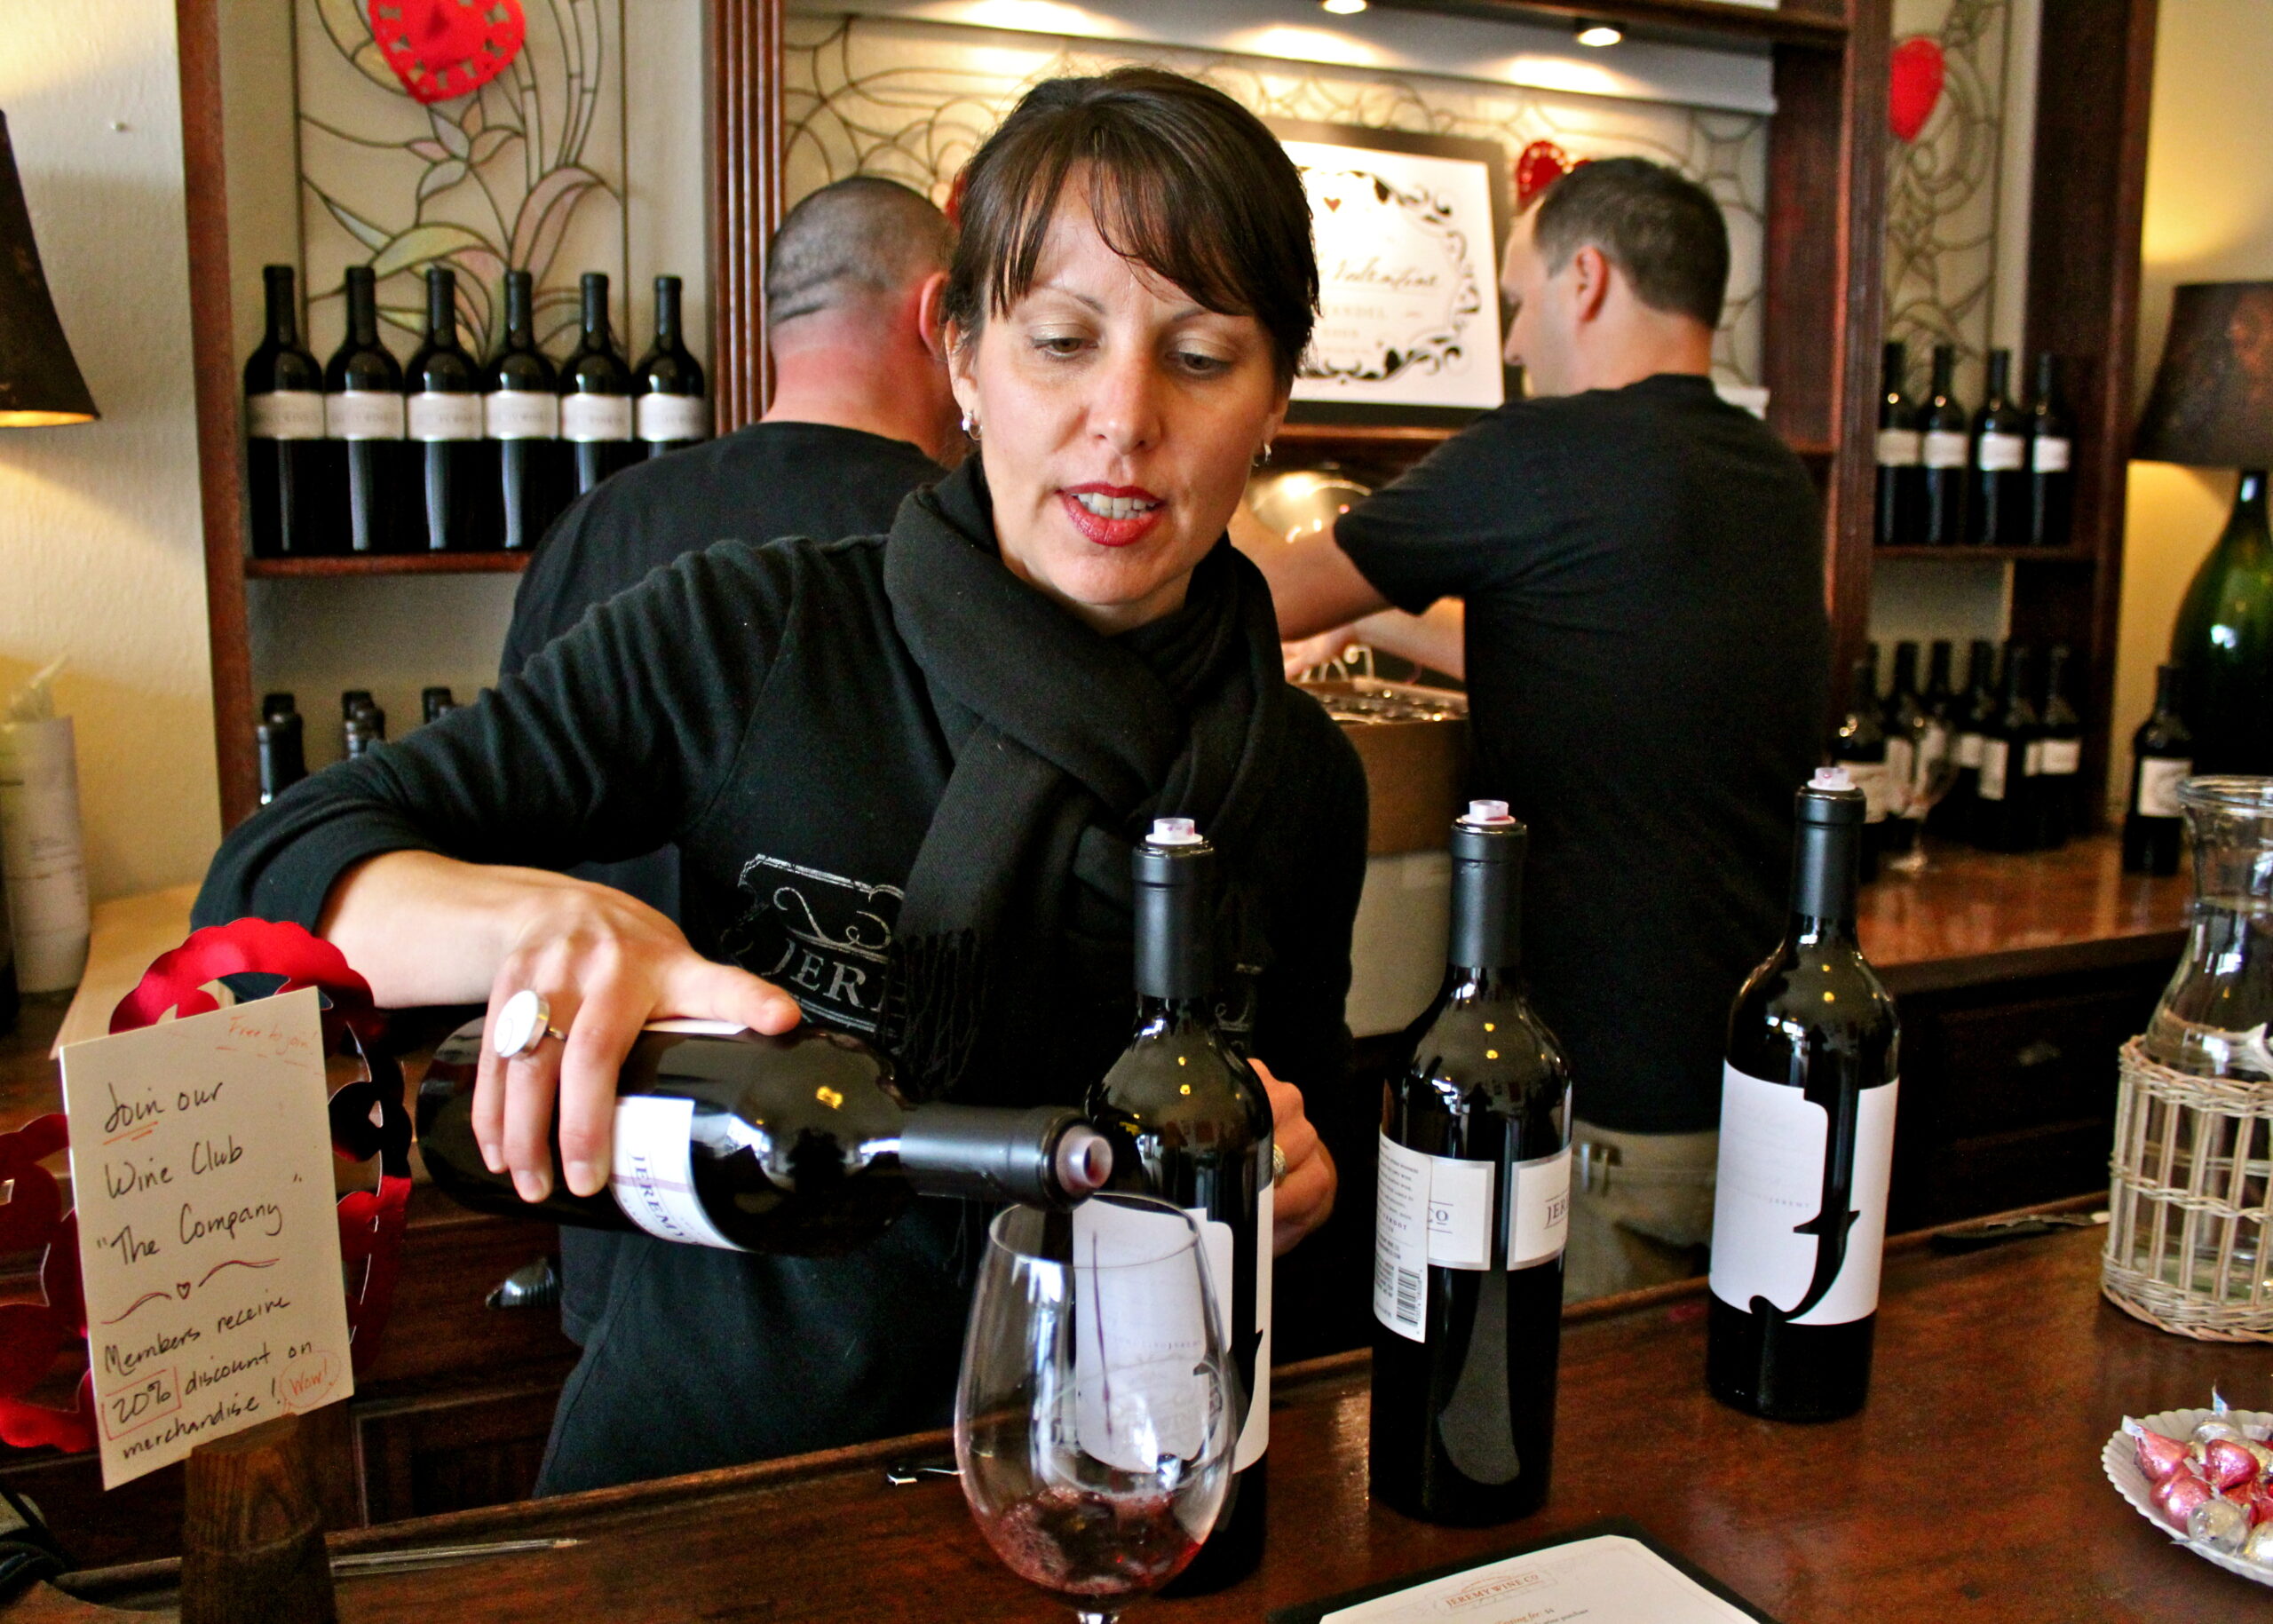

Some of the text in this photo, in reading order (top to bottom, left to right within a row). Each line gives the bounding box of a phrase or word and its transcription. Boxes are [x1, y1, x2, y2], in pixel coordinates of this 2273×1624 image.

[104, 1081, 223, 1133] Join our
[105, 1135, 243, 1199] Wine Club
[105, 1325, 201, 1375] Members
[112, 1341, 312, 1424] 20% discount on
[289, 1358, 335, 1397] Wow!
[1445, 1587, 1489, 1607] JEREMY
[1491, 1579, 1521, 1592] WINE
